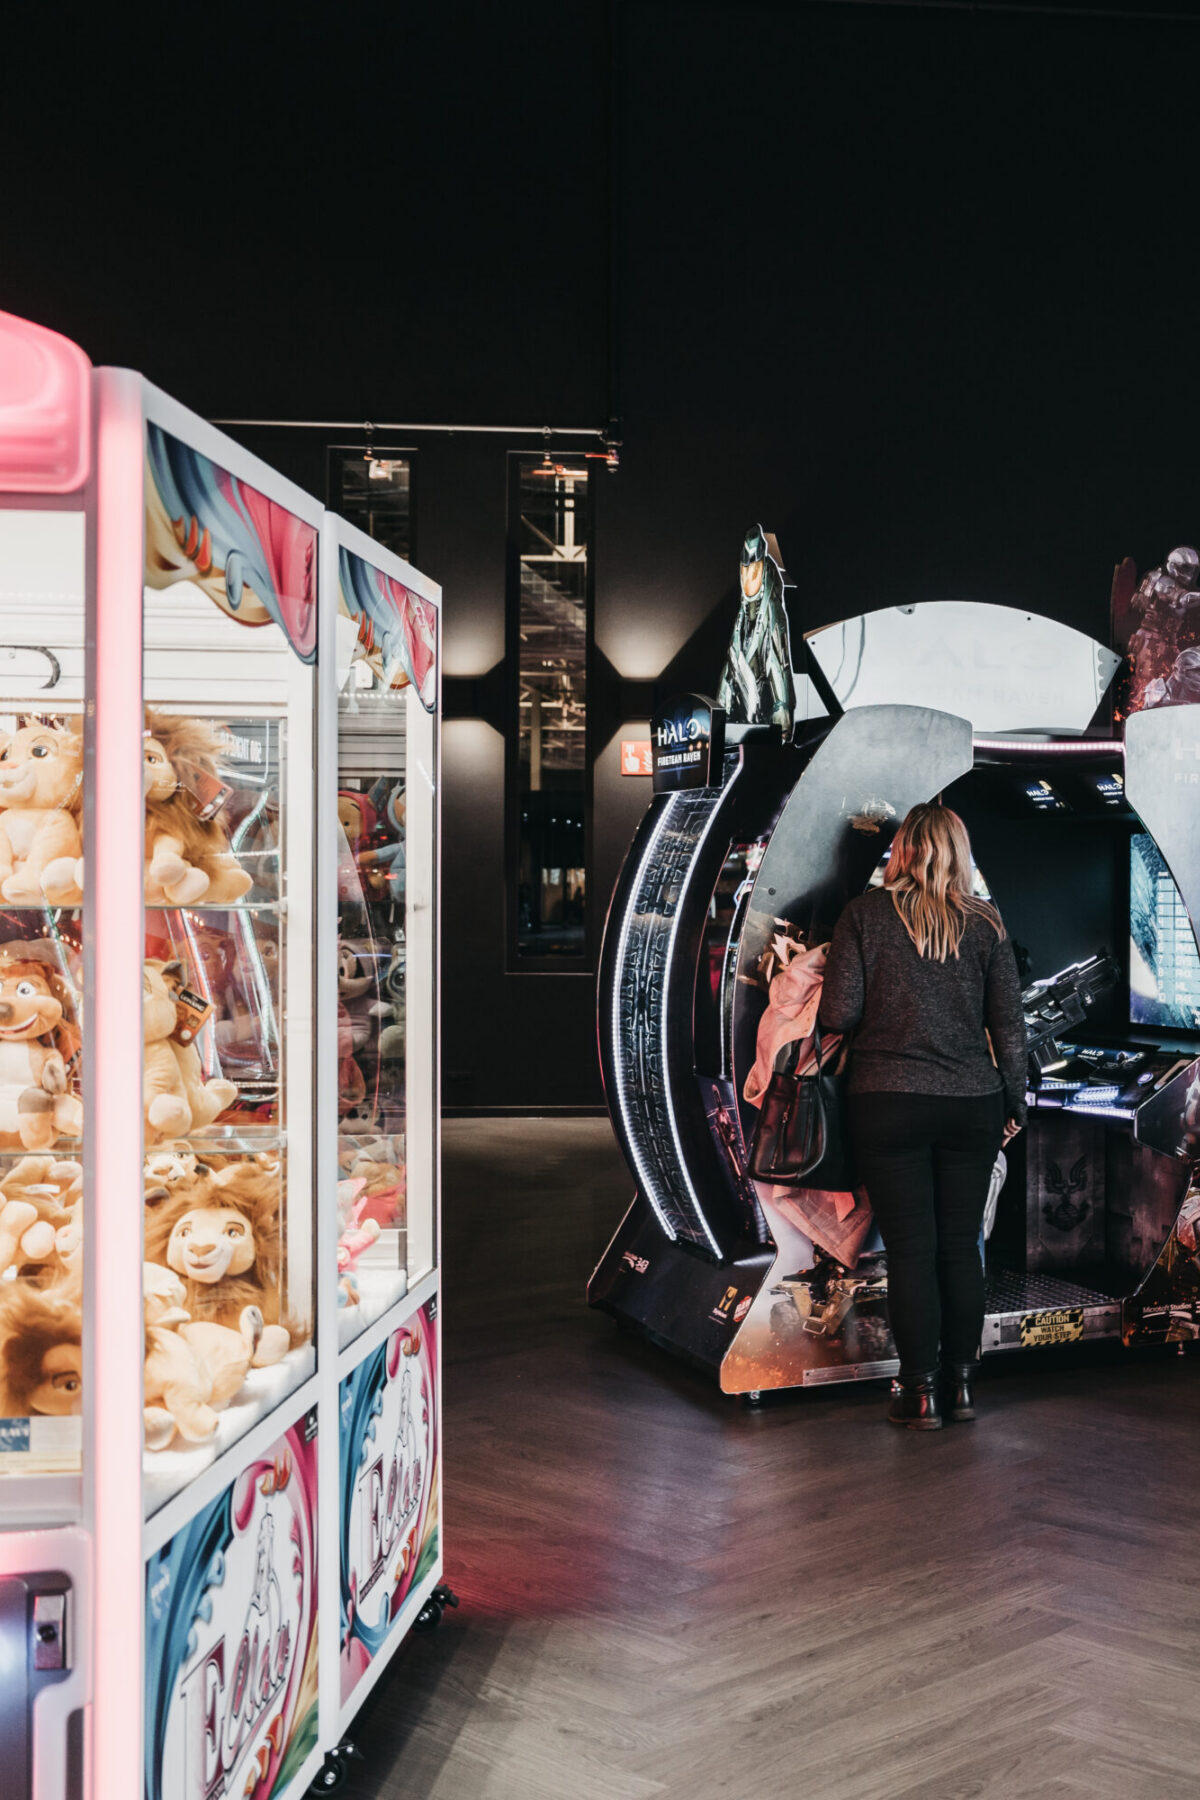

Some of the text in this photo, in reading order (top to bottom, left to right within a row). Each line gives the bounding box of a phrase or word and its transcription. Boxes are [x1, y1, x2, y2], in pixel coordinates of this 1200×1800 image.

[657, 718, 701, 747] HALO
[657, 751, 701, 767] FIRETEAM RAVEN
[1143, 1305, 1169, 1313] Microsoft
[1035, 1314, 1070, 1326] CAUTION
[1040, 1325, 1064, 1334] WATCH
[1033, 1331, 1072, 1342] YOUR STEP
